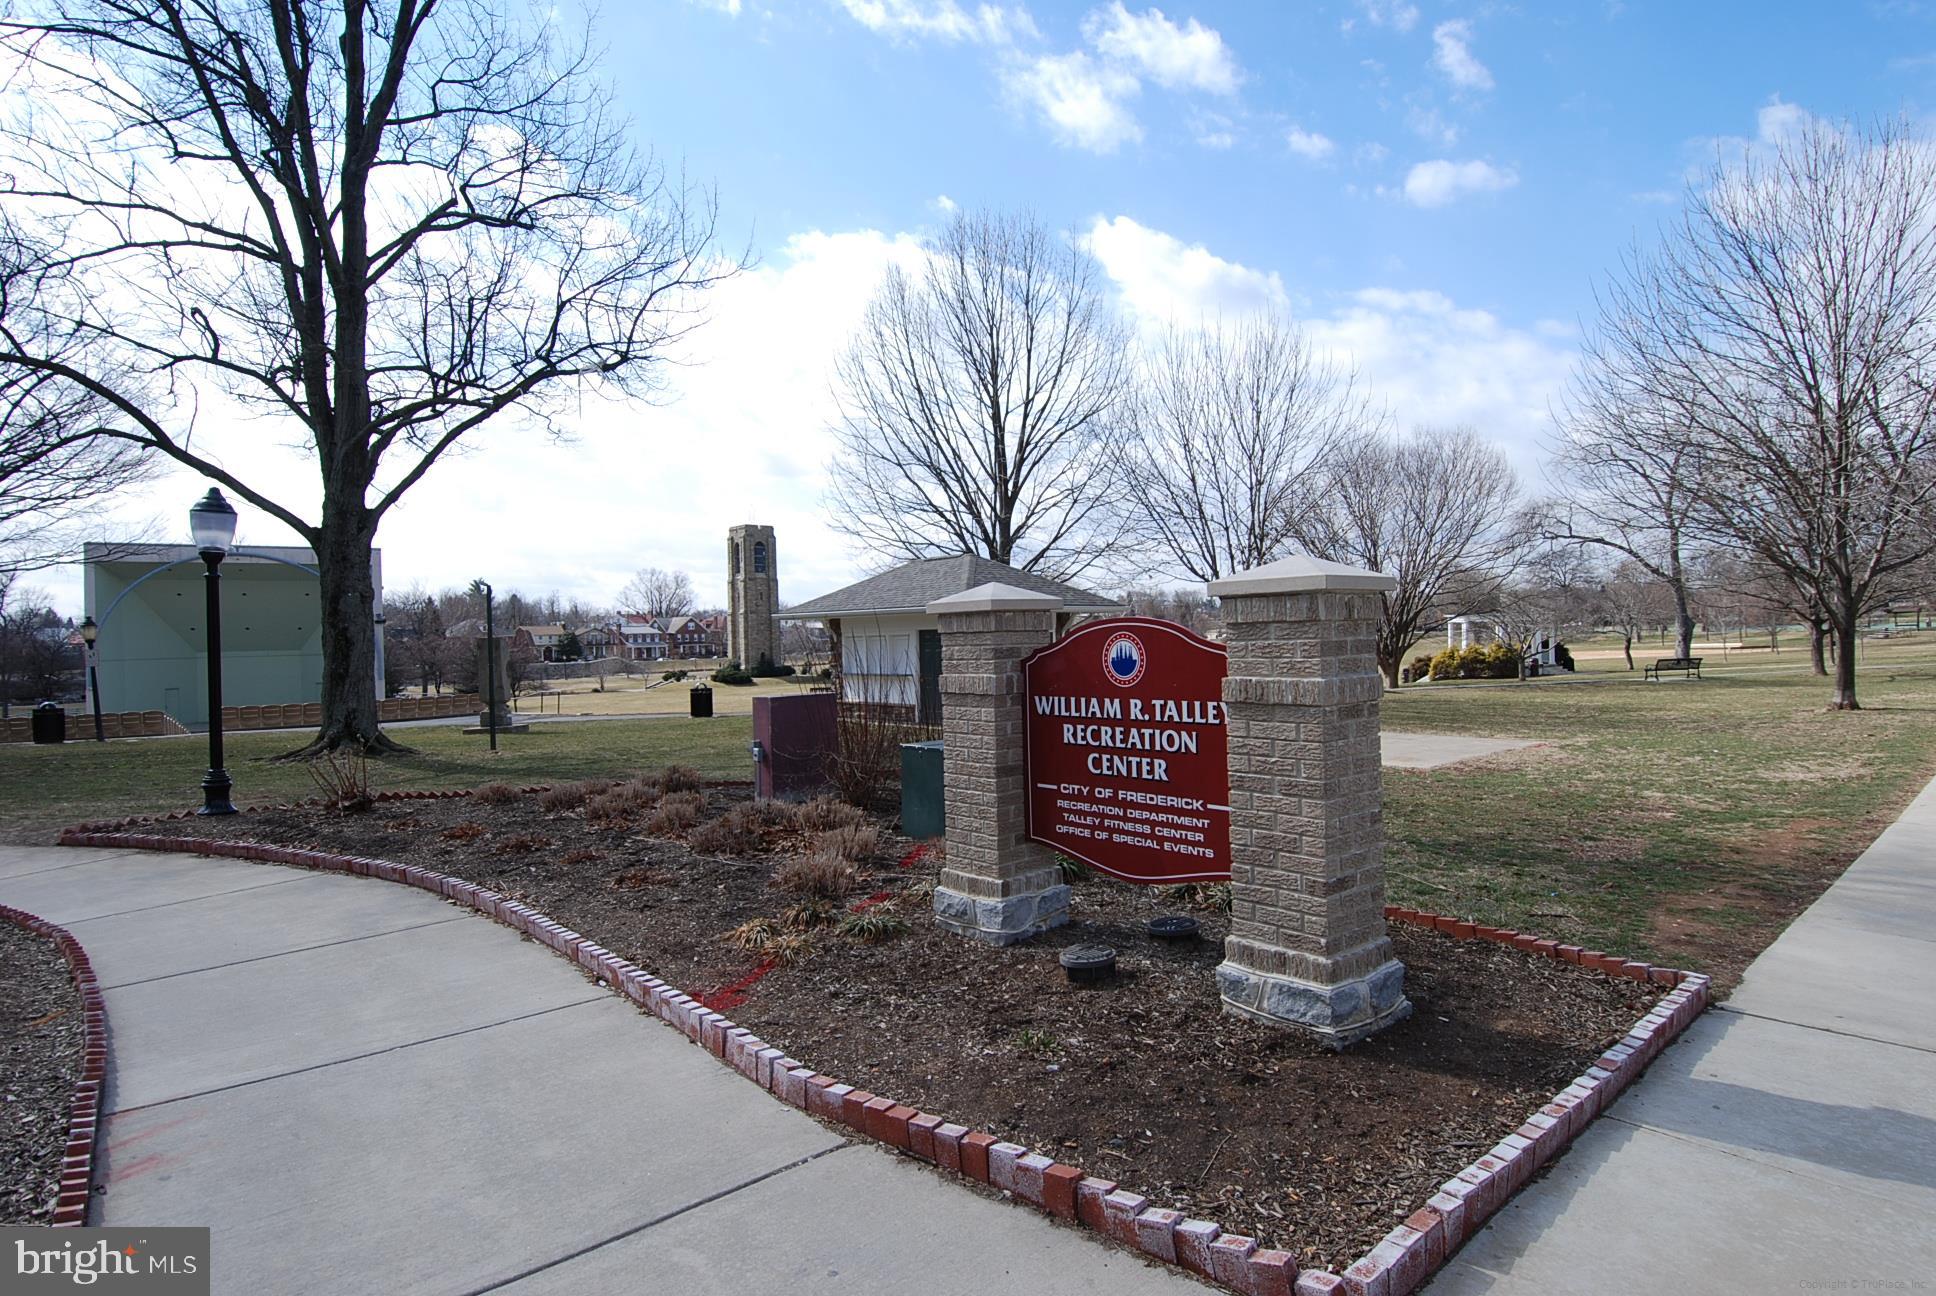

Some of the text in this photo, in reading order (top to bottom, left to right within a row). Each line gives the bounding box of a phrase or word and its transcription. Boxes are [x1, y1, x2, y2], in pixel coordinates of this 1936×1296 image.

[1034, 696, 1229, 725] WILLIAM R. TALLEY
[1063, 724, 1198, 754] RECREATION
[1087, 752, 1169, 781] CENTER
[1060, 783, 1205, 811] CITY OF FREDERICK
[1057, 800, 1210, 828] RECREATION DEPARTMENT
[1063, 812, 1205, 842] TALLEY FITNESS CENTER
[1055, 824, 1215, 858] OFFICE OF SPECIAL EVENTS
